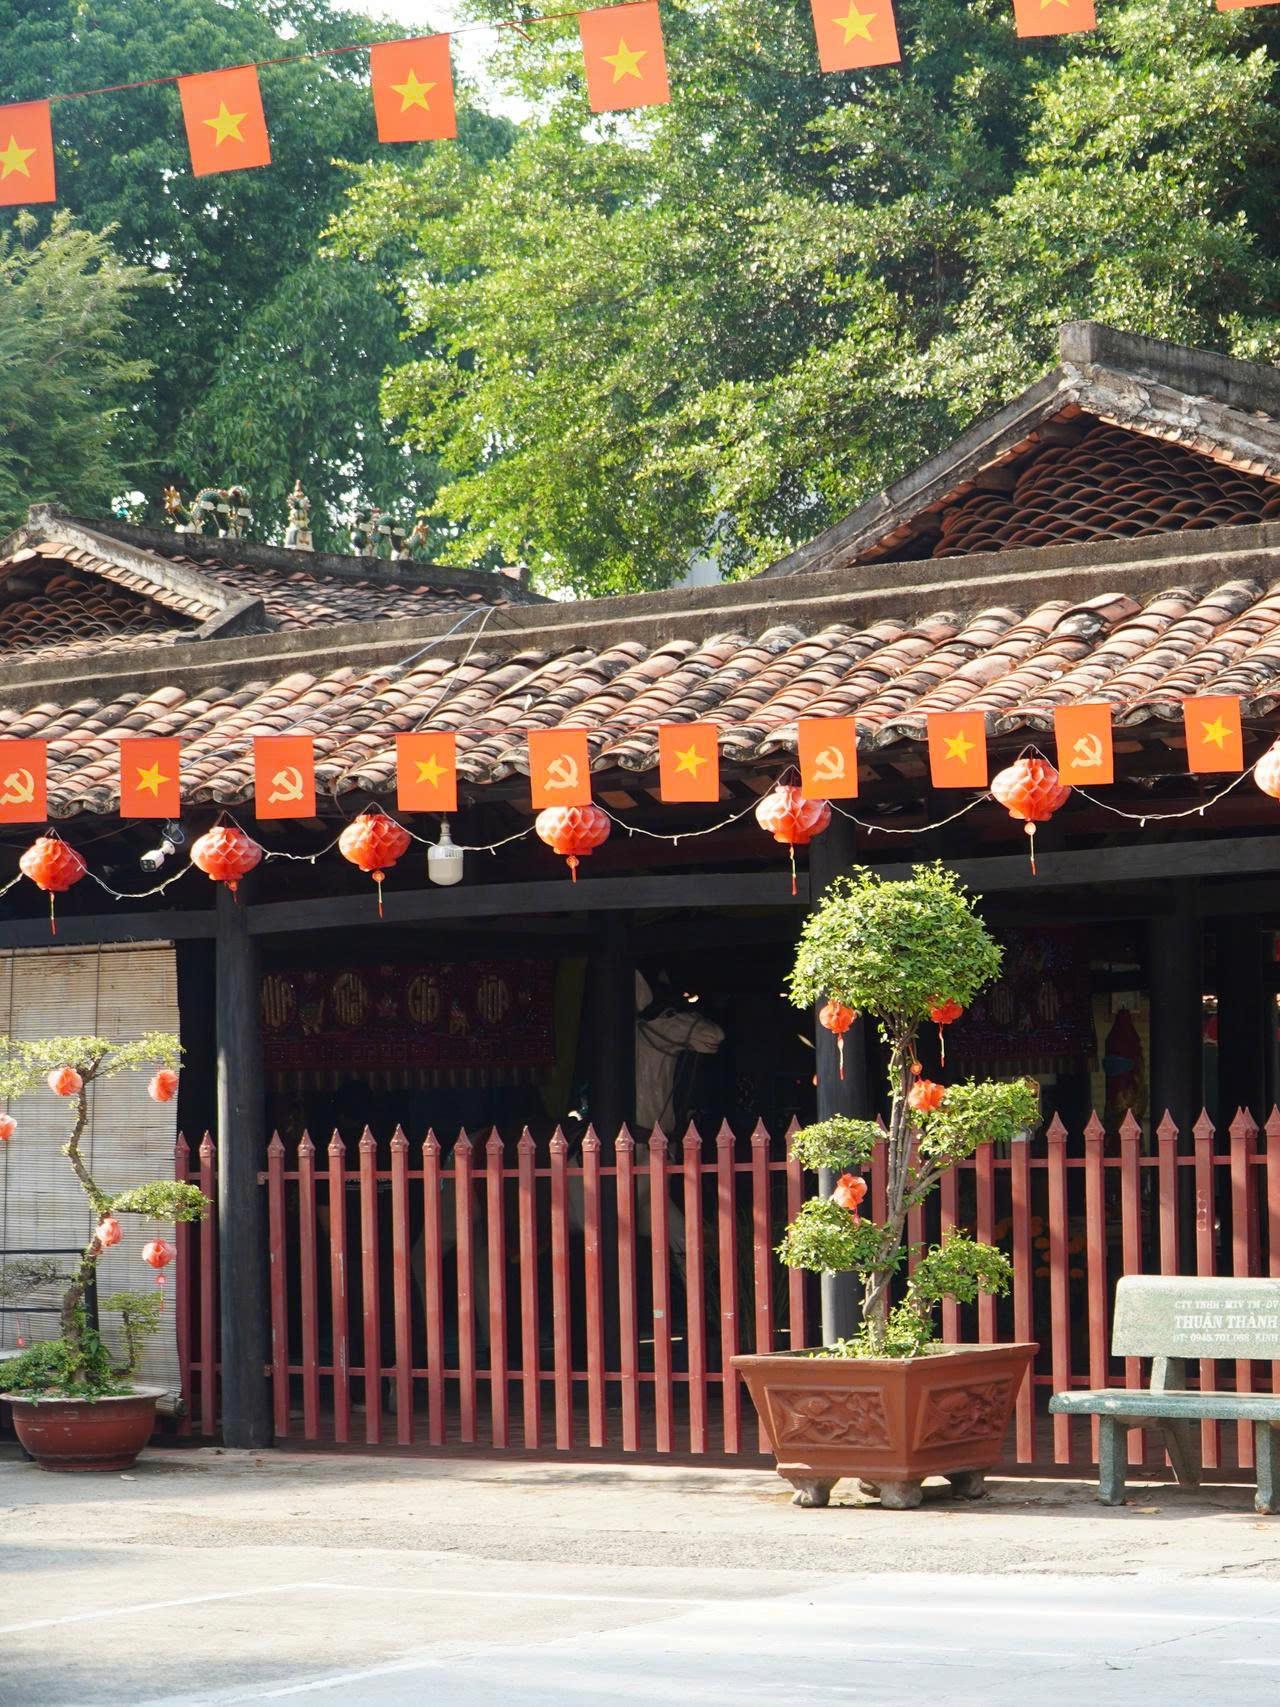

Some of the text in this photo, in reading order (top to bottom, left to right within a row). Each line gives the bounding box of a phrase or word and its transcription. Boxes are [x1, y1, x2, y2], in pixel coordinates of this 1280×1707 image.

[1174, 1299, 1193, 1310] CTY
[1174, 1312, 1223, 1333] THUẬN
[1226, 1311, 1279, 1329] THÀNH
